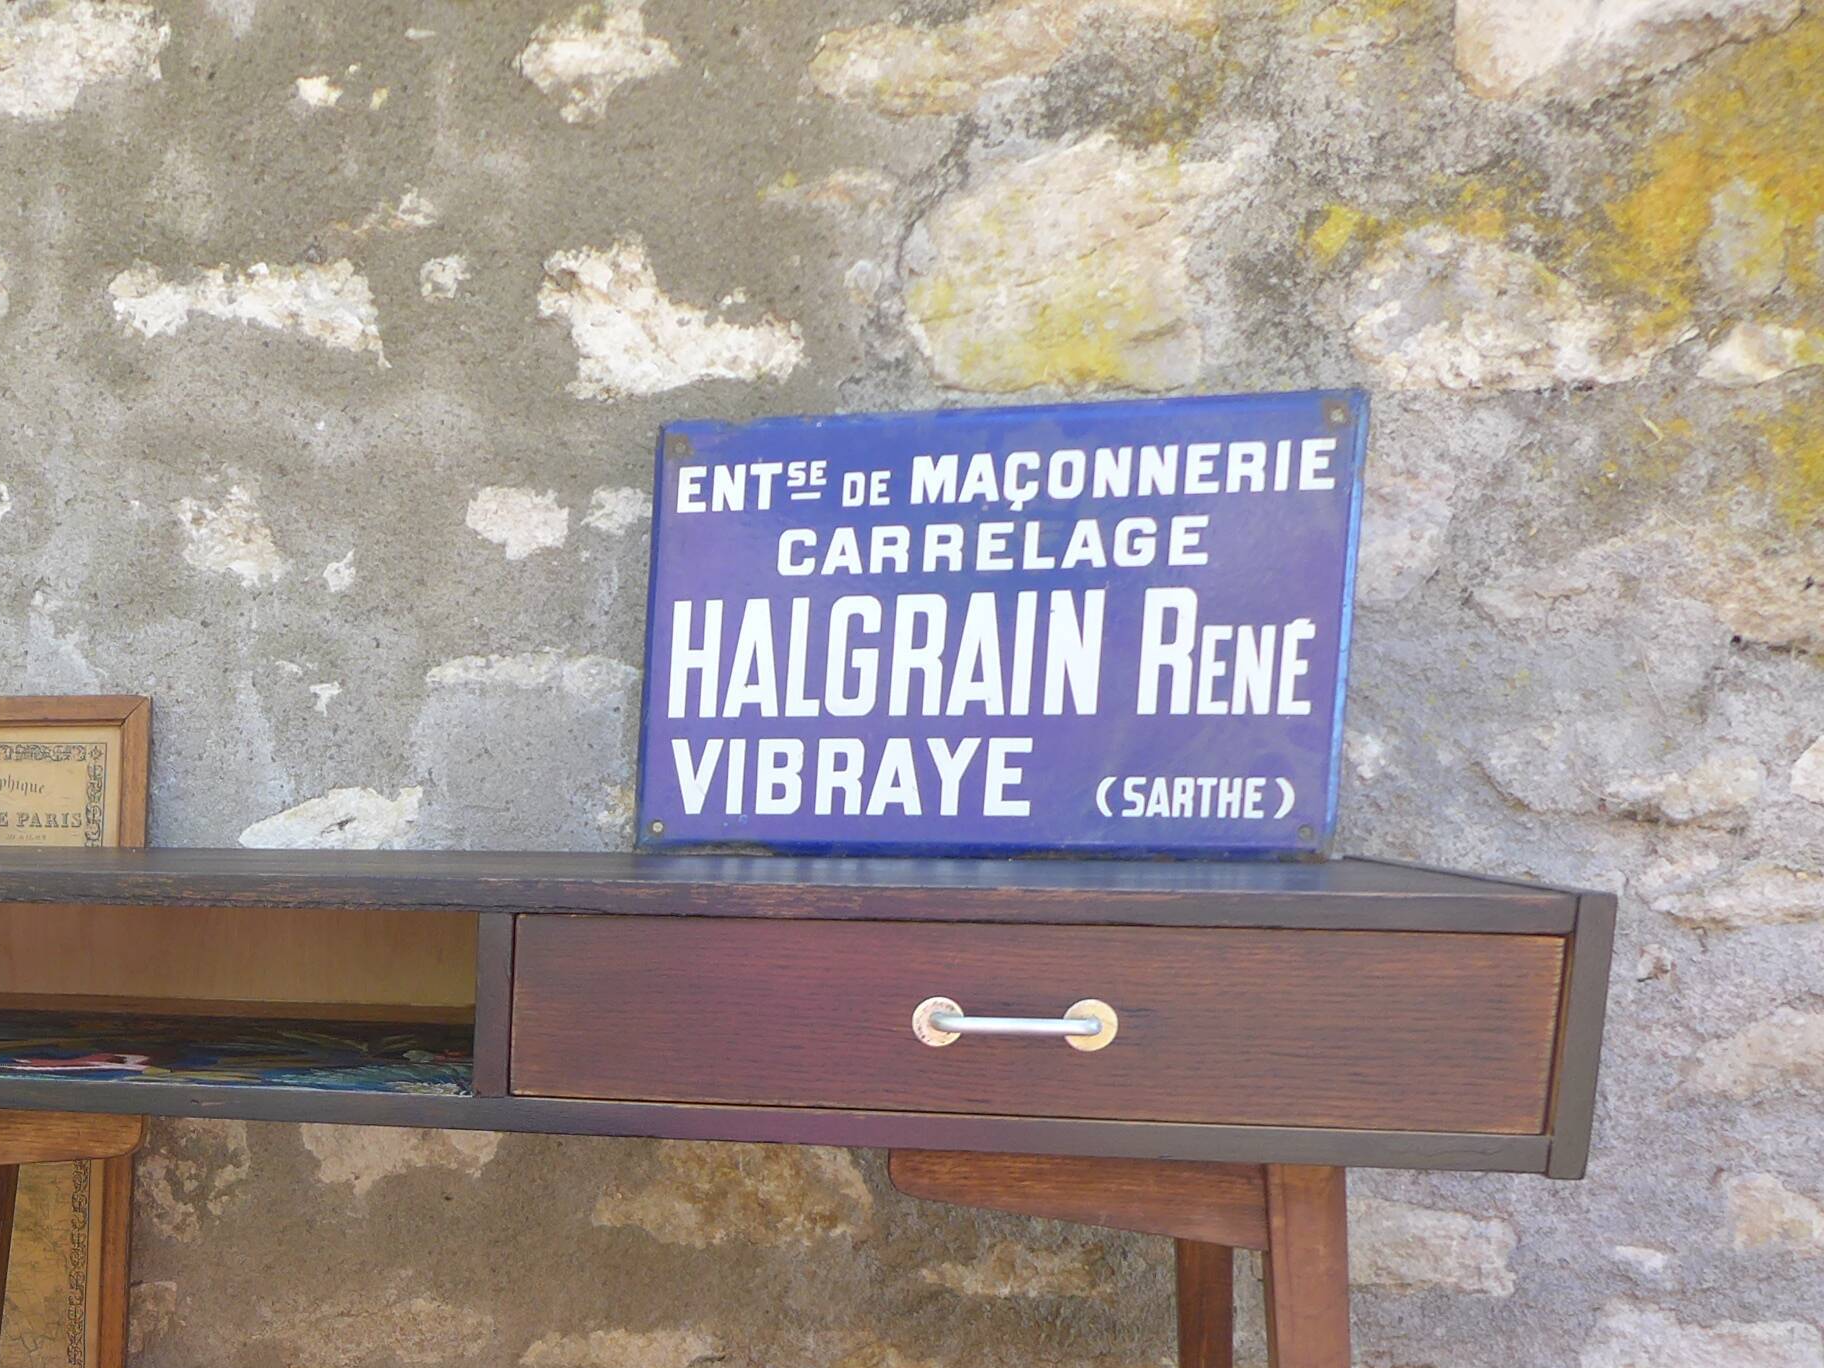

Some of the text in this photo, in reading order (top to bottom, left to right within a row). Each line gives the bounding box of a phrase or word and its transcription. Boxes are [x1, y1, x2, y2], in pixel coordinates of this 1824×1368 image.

[843, 471, 890, 506] DE
[911, 438, 1336, 511] MAÇONNERIE
[778, 515, 1209, 576] CARRELAGE
[668, 589, 1105, 718] HALGRAIN
[672, 738, 1295, 819] VIBRAYE (SARTHE)
[16, 811, 83, 829] PARIS
